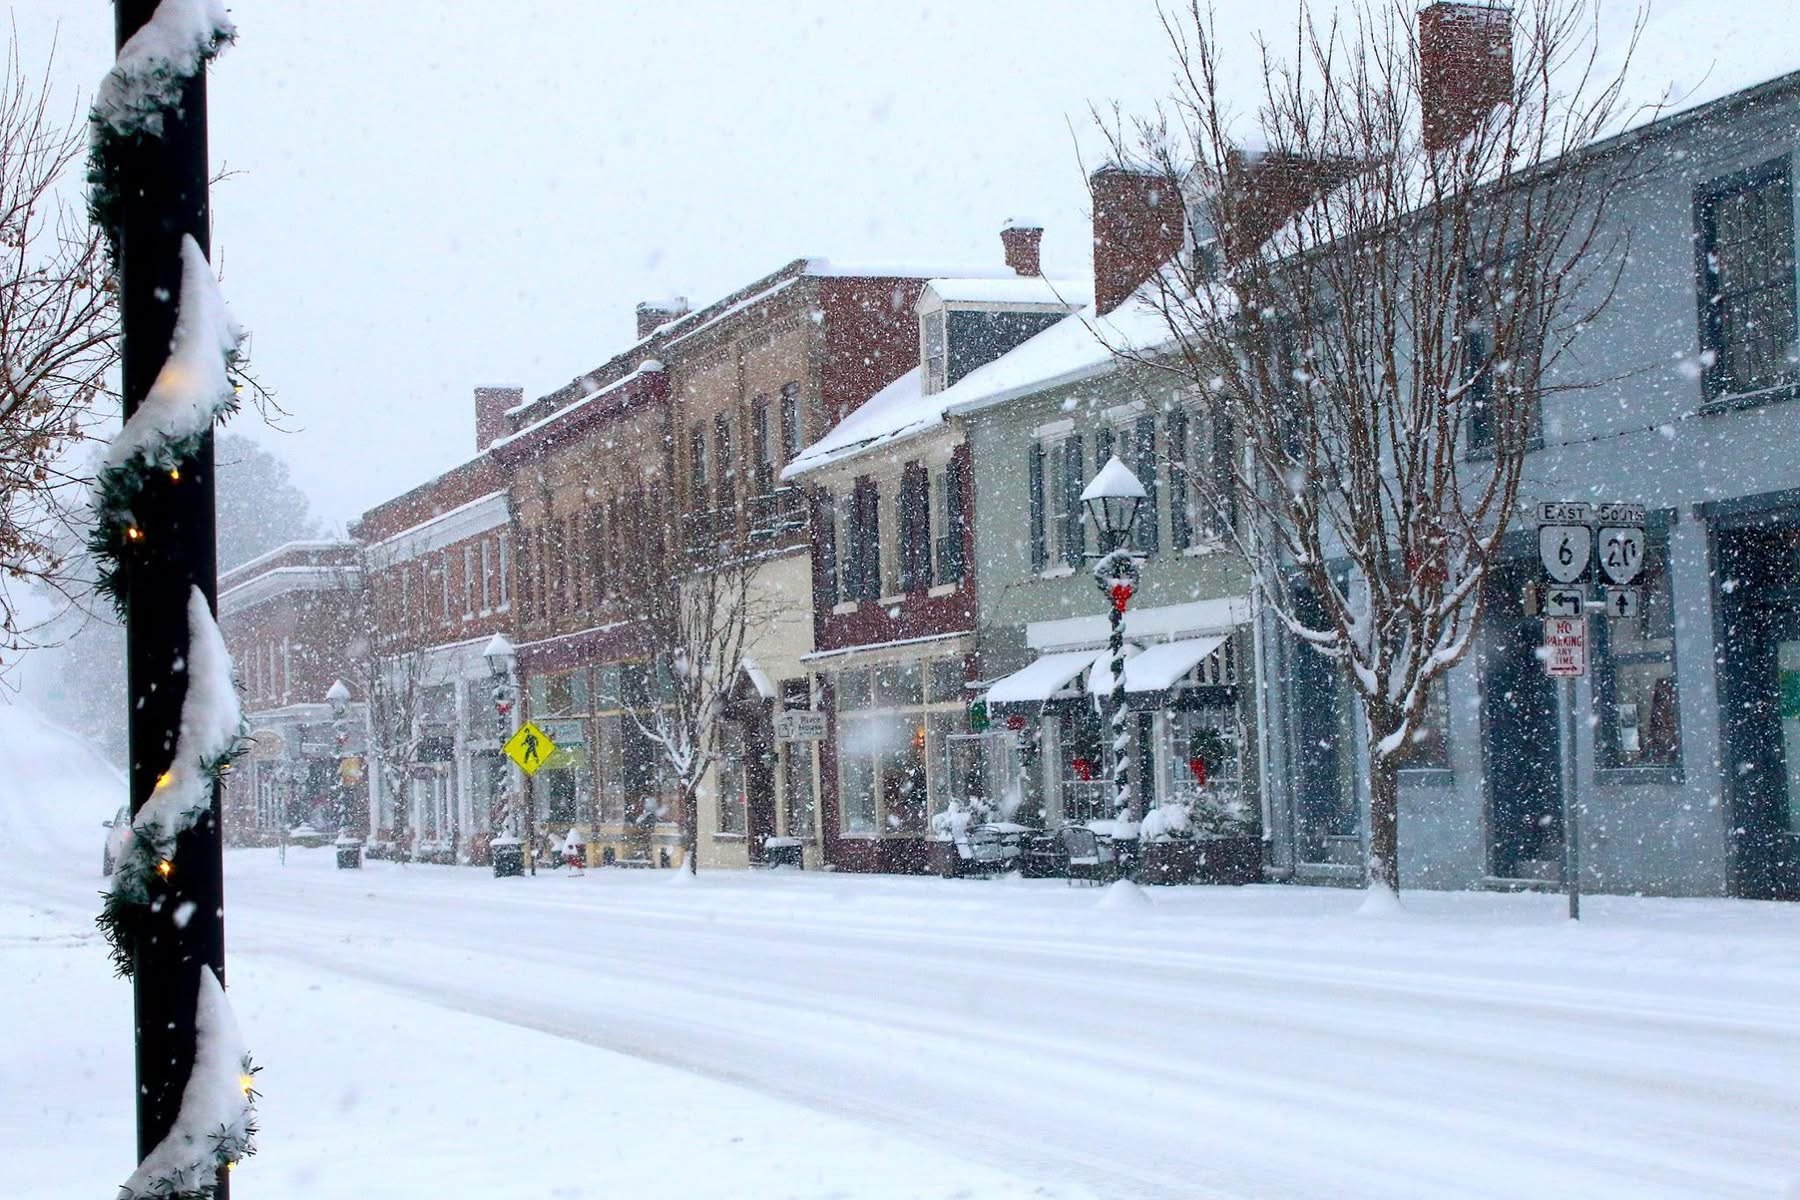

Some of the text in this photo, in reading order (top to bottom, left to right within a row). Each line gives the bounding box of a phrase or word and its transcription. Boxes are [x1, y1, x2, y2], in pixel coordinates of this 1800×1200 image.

[1544, 505, 1584, 520] EAST
[1558, 538, 1573, 566] 6
[1607, 538, 1636, 567] 20
[1556, 622, 1572, 634] NO
[1546, 635, 1582, 647] PARKING
[1556, 647, 1573, 656] ANY
[1555, 656, 1574, 665] TIME
